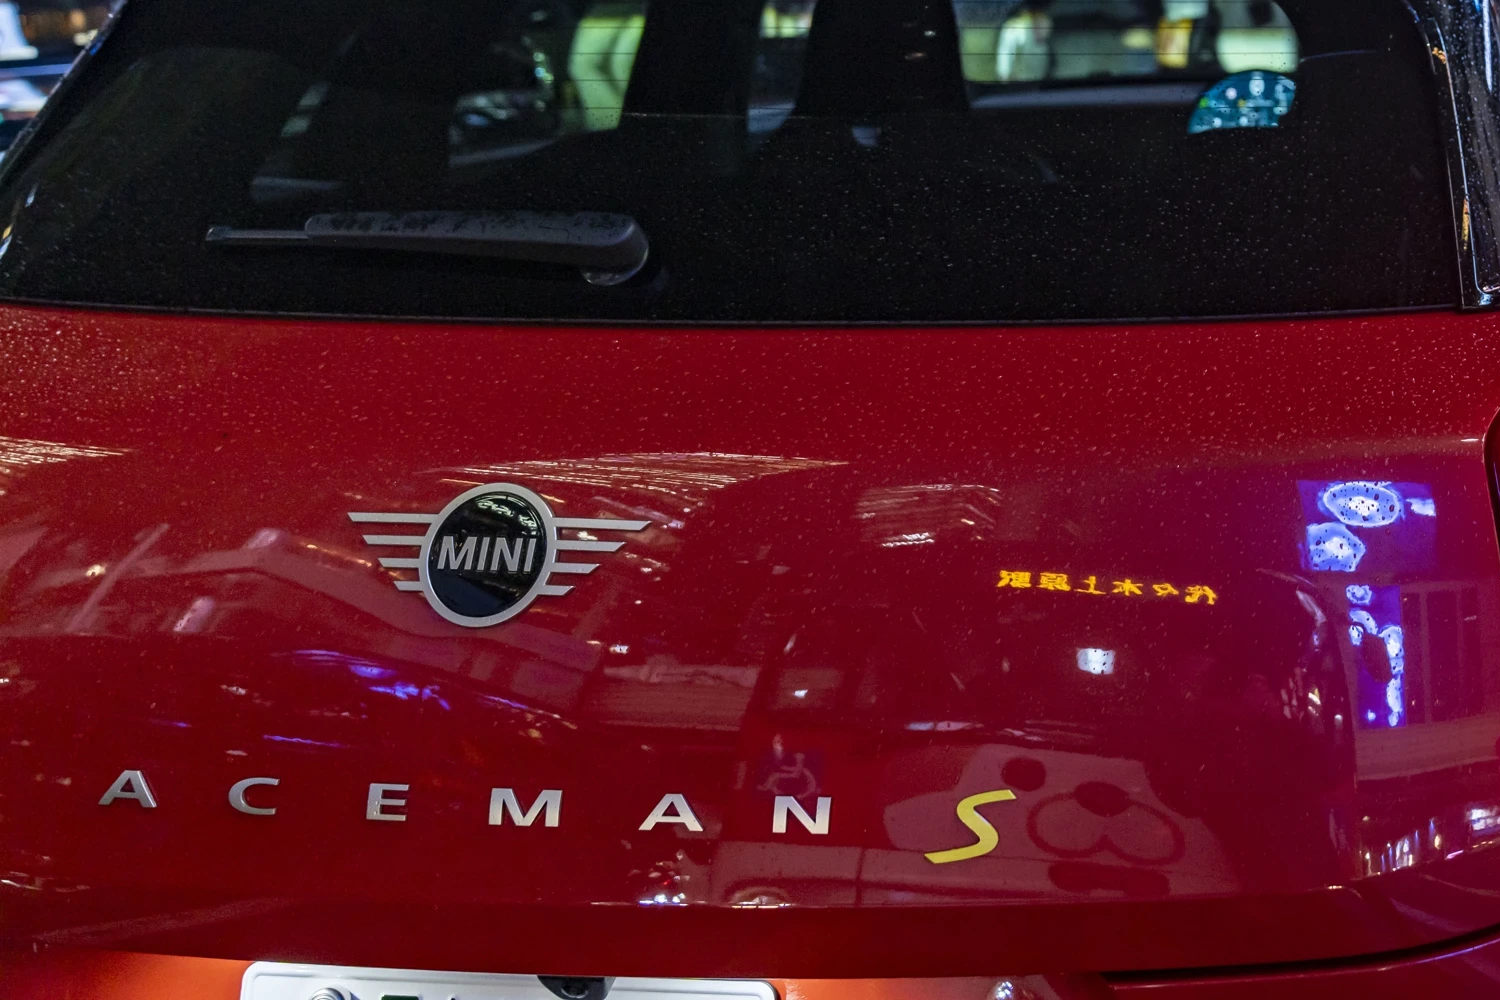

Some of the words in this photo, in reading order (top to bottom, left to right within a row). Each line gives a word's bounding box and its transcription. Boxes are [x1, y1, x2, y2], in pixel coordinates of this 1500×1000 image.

[436, 536, 536, 574] MINI
[99, 769, 832, 835] ACEMAN
[924, 789, 1017, 864] S
